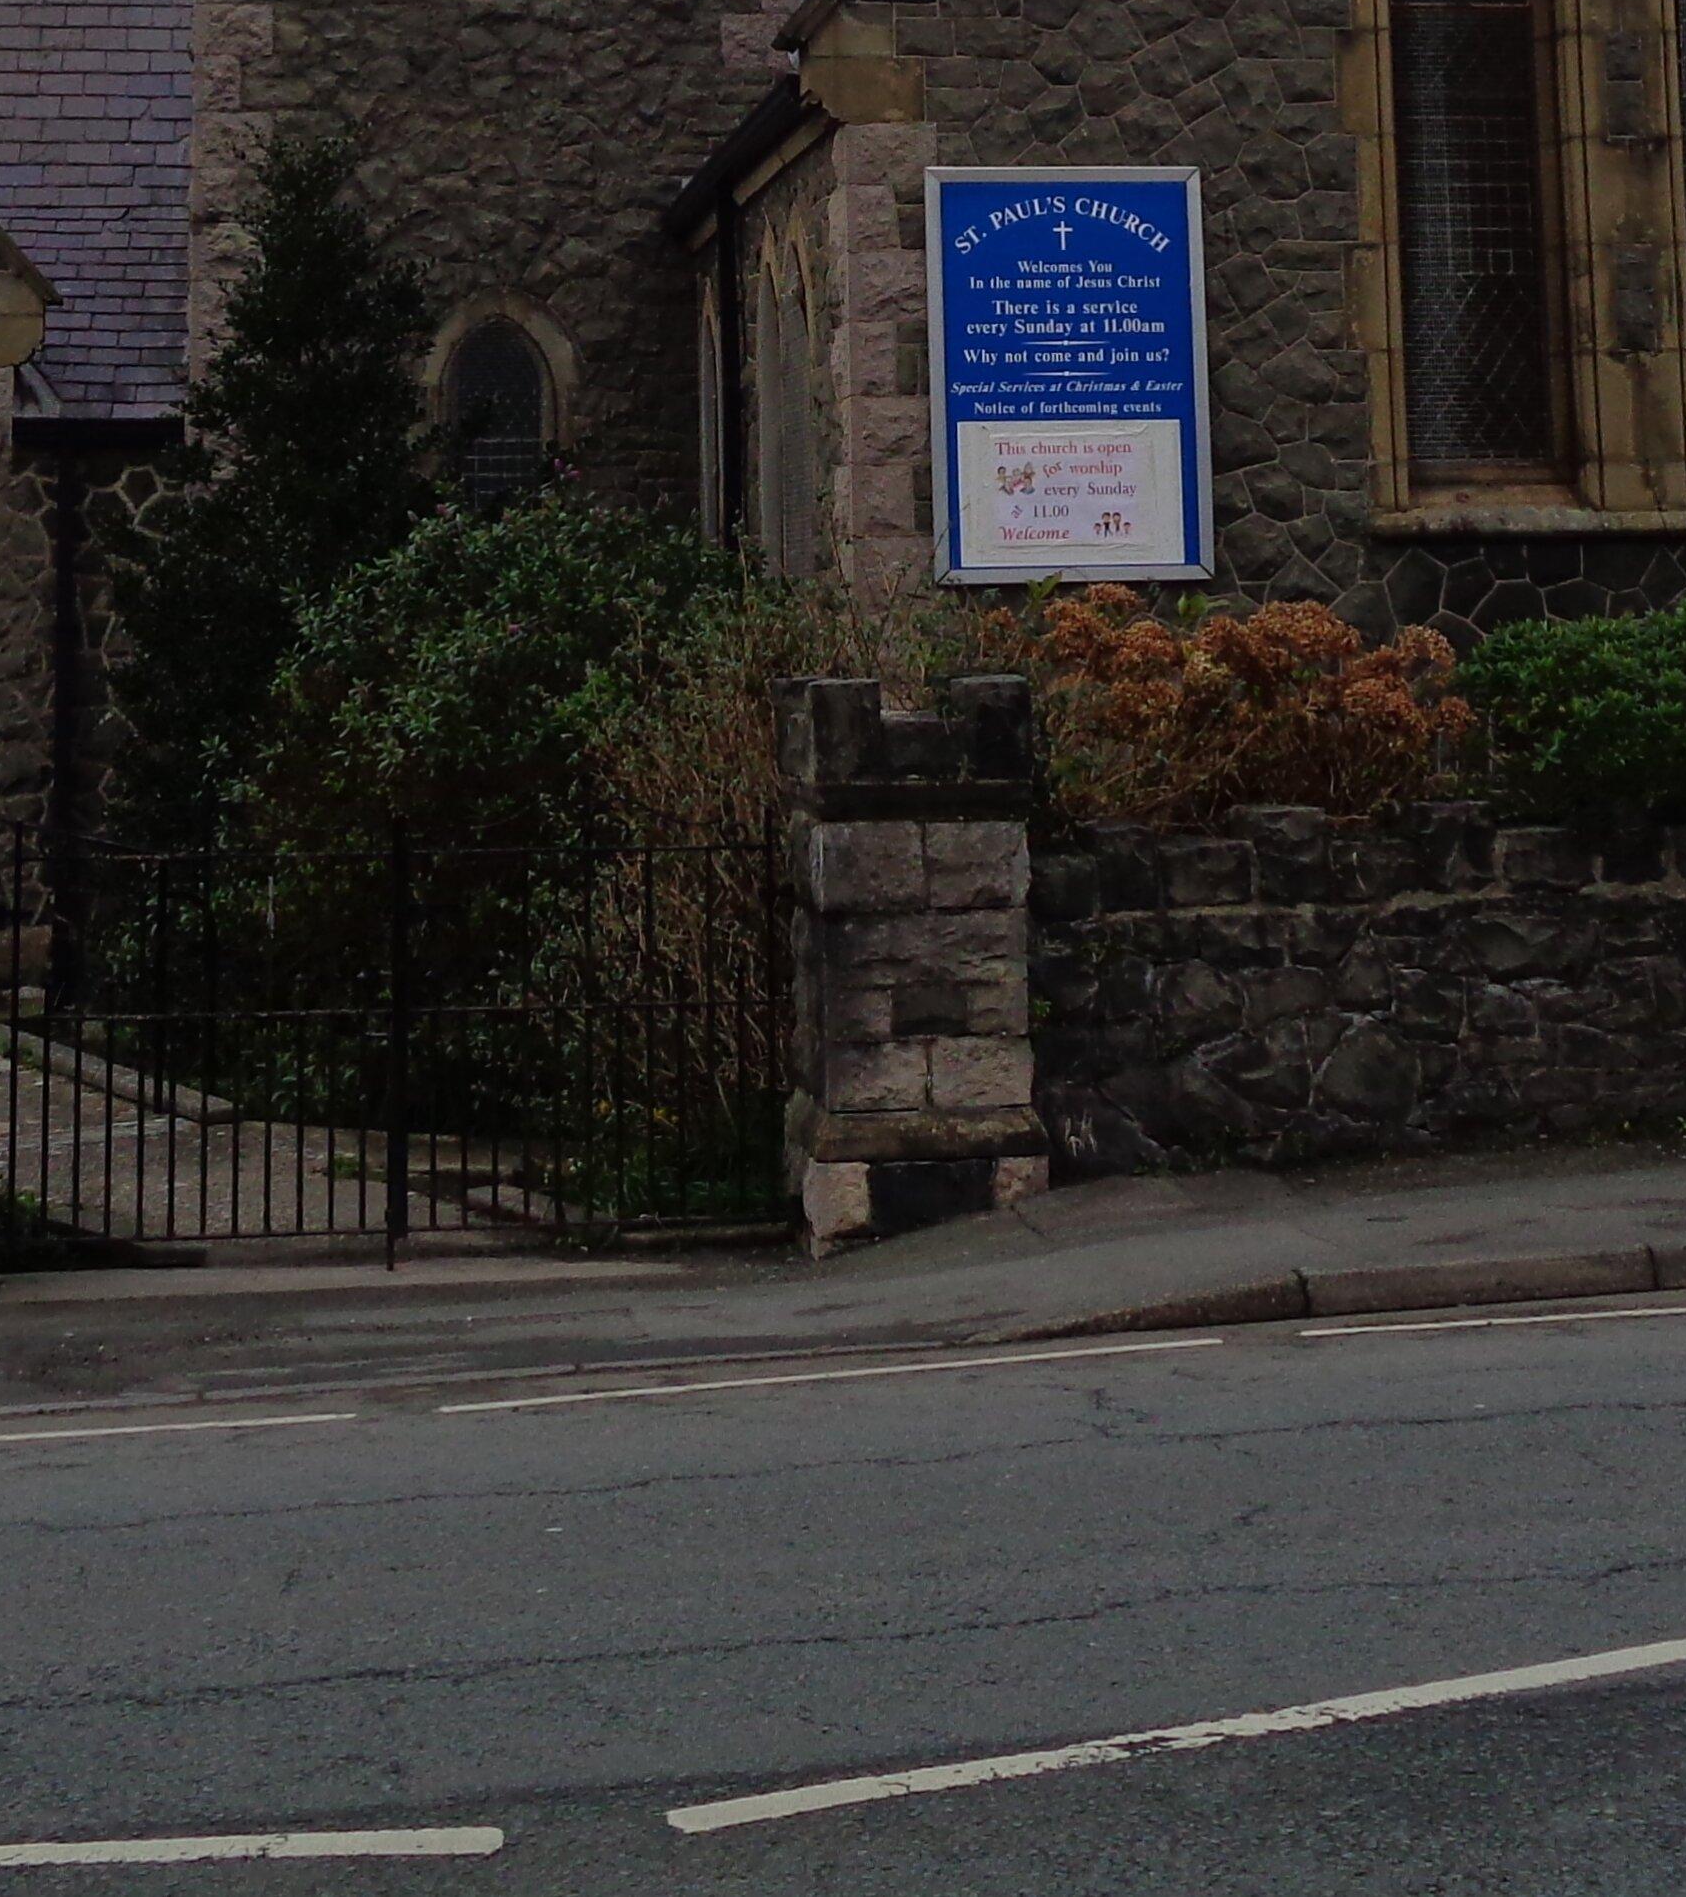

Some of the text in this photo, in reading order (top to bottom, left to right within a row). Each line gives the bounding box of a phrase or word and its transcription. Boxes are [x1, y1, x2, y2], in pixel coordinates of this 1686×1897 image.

[954, 195, 1170, 254] ST. PAUL'S CHURCH
[1018, 260, 1112, 273] Welcomes You
[970, 275, 1160, 289] In the name of Jesus Christ
[992, 300, 1137, 315] There is a service
[967, 318, 1165, 336] every Sunday at 11.00am
[964, 348, 1169, 365] Why not come and join us?
[951, 381, 1183, 395] Special Services at Christmas & Easter
[974, 402, 1162, 415] Notice of forthcoming events
[995, 441, 1131, 456] This church is open
[1043, 460, 1122, 478] for worship
[1044, 482, 1136, 498] every Sunday
[1033, 505, 1069, 518] 11.00
[1000, 526, 1070, 540] Welcome
